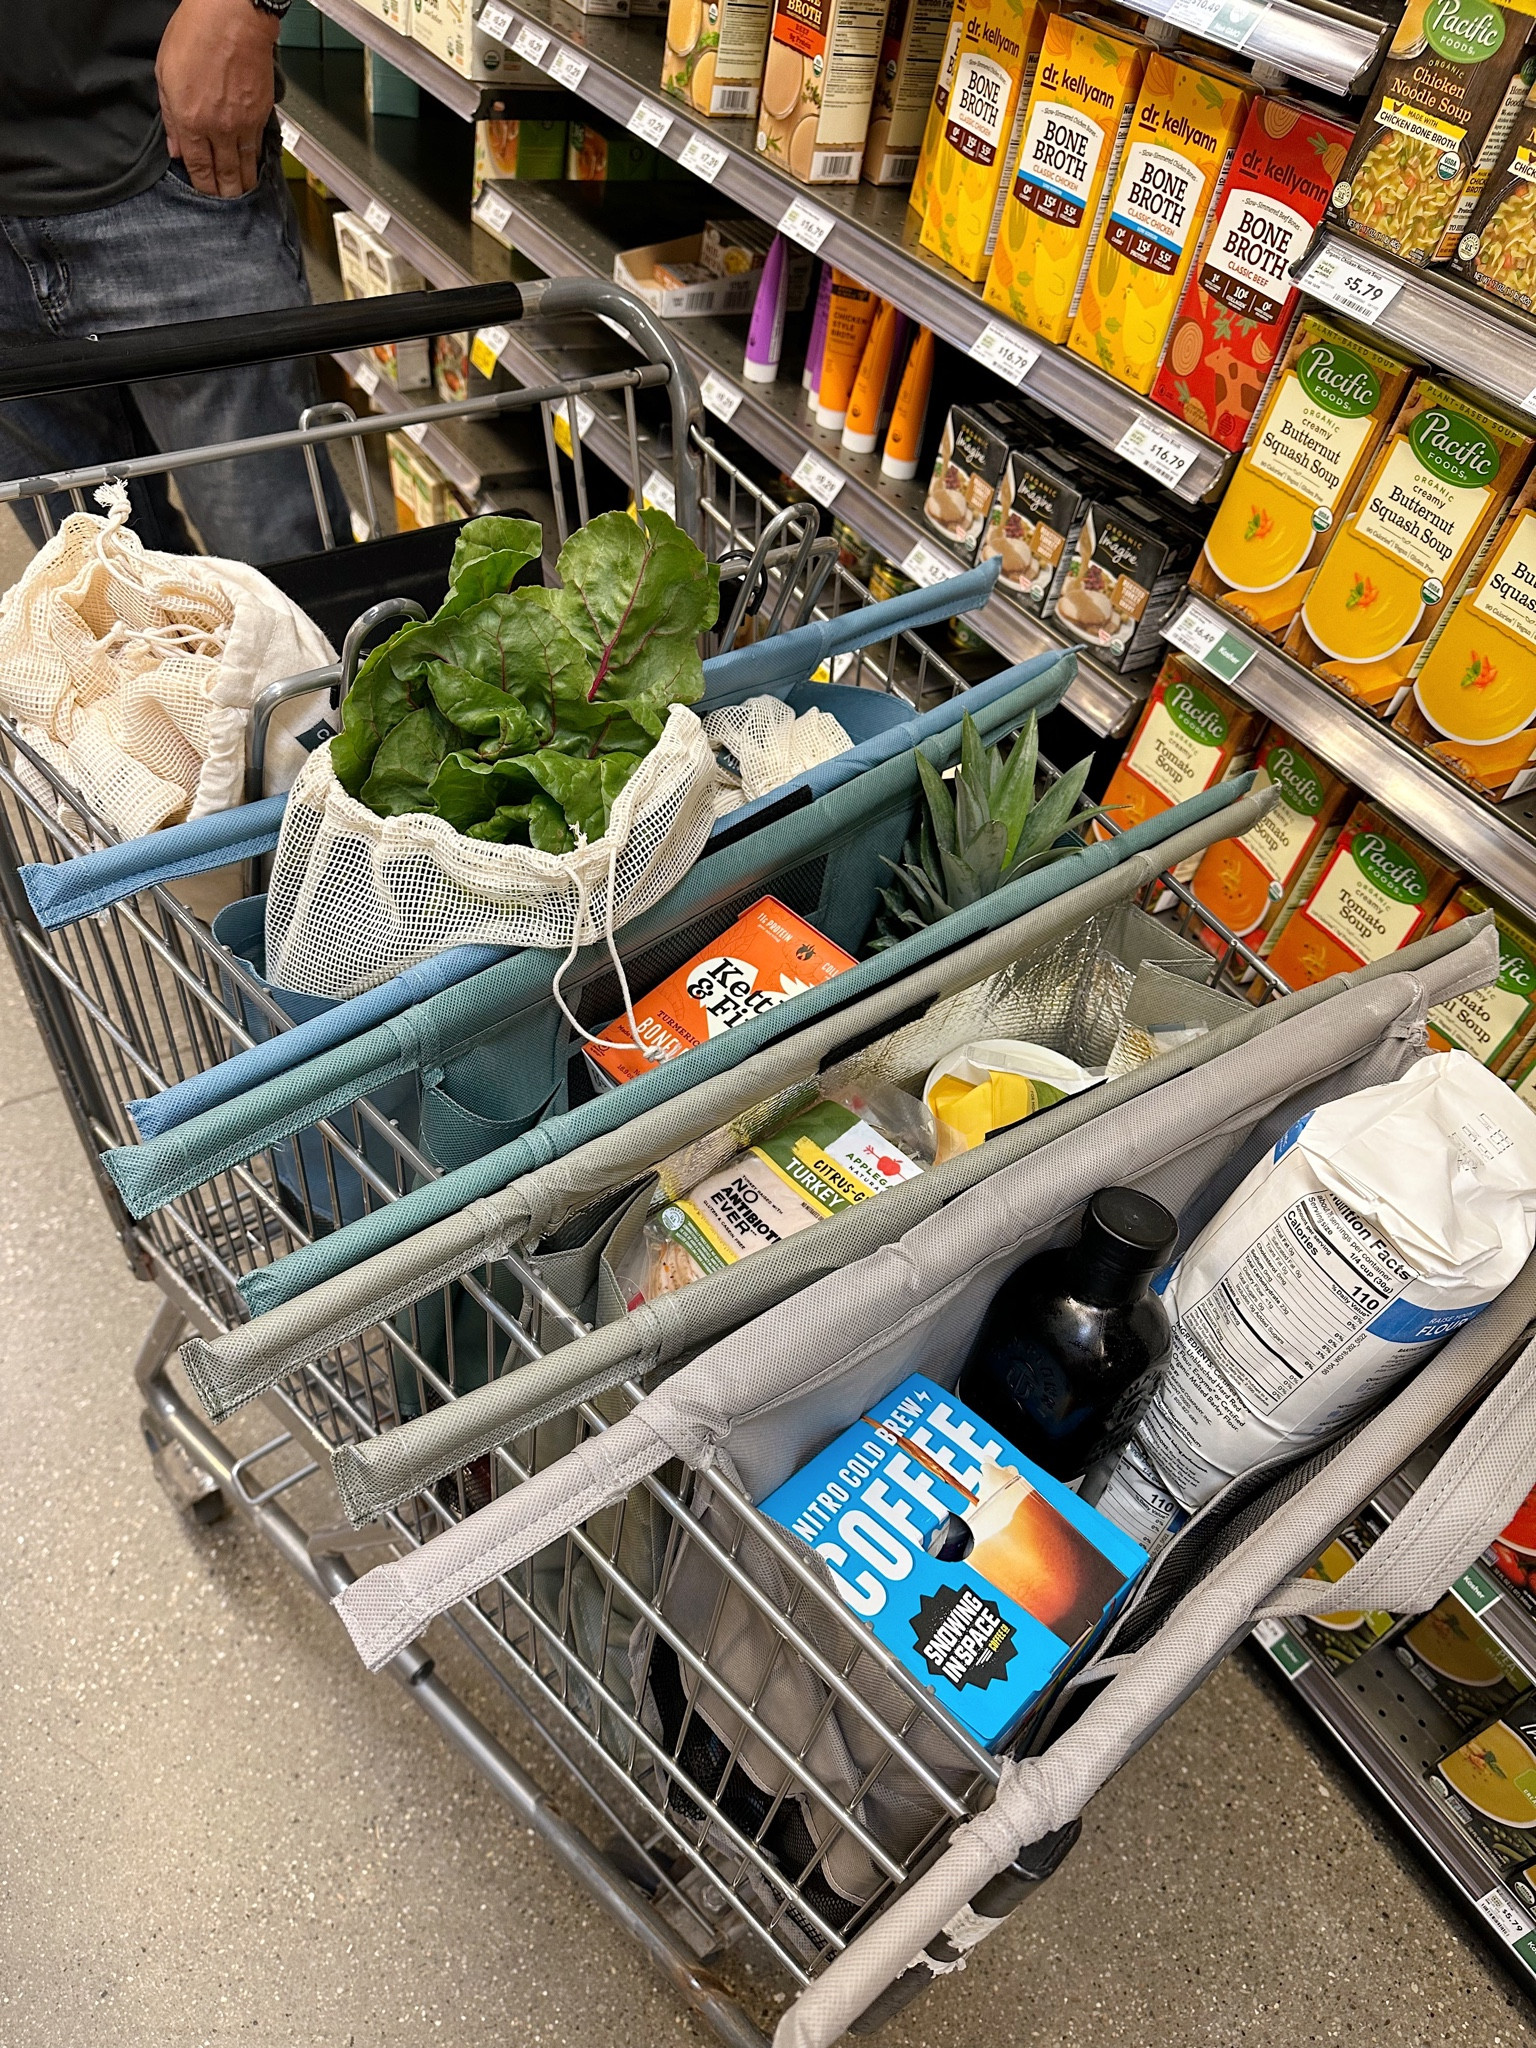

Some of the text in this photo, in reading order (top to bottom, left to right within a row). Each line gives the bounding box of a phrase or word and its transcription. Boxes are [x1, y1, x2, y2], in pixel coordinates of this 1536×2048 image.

[787, 2, 822, 25] BROTH
[1432, 0, 1499, 47] Pacific
[966, 17, 1020, 58] dr. kellyann
[969, 70, 1001, 102] BONE
[1042, 63, 1115, 110] dr. kellyann
[1413, 66, 1466, 100] Chicken
[1428, 60, 1465, 79] ORGANIC
[959, 89, 999, 128] BROTH
[1391, 78, 1472, 125] Noodle Soup
[1407, 110, 1438, 128] MADE WITH
[1043, 120, 1089, 158] BONE
[1141, 104, 1217, 154] dr. kellyann
[1380, 111, 1457, 150] CHICKEN BONE BROTH
[1032, 139, 1088, 182] BROTH
[1032, 164, 1055, 181] CLASSIC
[1054, 173, 1079, 191] CHICKEN
[1241, 151, 1262, 173] dr.
[1264, 158, 1329, 205] kellyann
[1140, 162, 1189, 202] BONE
[1127, 182, 1187, 227] BROTH
[1127, 207, 1175, 236] CLASSIC CHICKEN
[1238, 210, 1293, 253] BONE
[1223, 231, 1290, 281] BROTH
[1228, 261, 1269, 287] CLASSIC BEEF
[1344, 276, 1383, 300] $5.79
[999, 345, 1028, 369] $16.79
[1311, 323, 1395, 370] PLANT-BASED SOUP
[1307, 347, 1373, 406] Pacific
[1301, 418, 1333, 441] creamy
[1303, 408, 1340, 433] ORGANIC
[1427, 385, 1517, 440] PLANT-BASED SOUP
[1150, 443, 1185, 471] $16.79
[1263, 432, 1309, 471] Squash
[1310, 461, 1339, 490] Soup
[1280, 420, 1342, 465] Butternut
[1419, 412, 1492, 475] Pacific
[1017, 478, 1053, 514] Imagine
[1413, 485, 1447, 509] creamy
[1414, 474, 1454, 503] ORGANIC
[1369, 497, 1453, 561] Squash Soup
[1388, 485, 1455, 536] Butternut
[1098, 529, 1138, 565] Imagine
[1106, 523, 1143, 550] ORGANIC
[1194, 625, 1215, 644] $6.49
[1218, 646, 1241, 665] Kosher
[1171, 683, 1222, 739] Pacific
[1155, 738, 1195, 779] Tomato
[1155, 757, 1183, 785] Soup
[1273, 747, 1320, 808] Pacific
[1359, 833, 1420, 898] Pacific
[1338, 888, 1387, 937] Tomato
[1355, 888, 1385, 915] creamy
[1356, 881, 1392, 912] ORGANIC
[766, 919, 793, 942] PROTEIN
[1338, 907, 1373, 940] Soup
[687, 977, 713, 1000] &
[656, 1010, 701, 1047] TURMERIC
[1456, 1009, 1491, 1044] Soup
[731, 1177, 758, 1204] NO
[757, 1189, 773, 1206] RAISED
[785, 1156, 845, 1208] TURKEY
[813, 1159, 867, 1202] CITRUS-G
[849, 1165, 880, 1191] NATURA
[703, 1200, 735, 1239] GLUTEN CASEIN
[1274, 1224, 1284, 1238] Total
[1295, 1204, 1332, 1256] Amount per serving
[1250, 1248, 1264, 1270] Sodium
[1256, 1242, 1278, 1274] Cholesterol
[1287, 1210, 1380, 1311] Calories 110
[1308, 1196, 1394, 1294] Serving size 1/4 cup (30g)
[1331, 1215, 1393, 1282] servings per container
[1369, 1238, 1411, 1281] Facts
[1224, 1277, 1237, 1298] Protein
[1245, 1255, 1281, 1305] Total Carbohydrate
[1336, 1289, 1351, 1304] Daily
[1175, 1321, 1215, 1370] INGREDIENTS:
[1415, 1318, 1469, 1337] FLOUR
[1172, 1352, 1239, 1432] Organic Malted Barley Flour.
[1179, 1349, 1192, 1370] Flour,
[1220, 1399, 1246, 1427] Certified
[1186, 1348, 1242, 1413] Unbleached Hard Red
[791, 1396, 926, 1543] NITRO COLD BREW
[814, 1402, 1003, 1617] COFFEE
[1151, 1493, 1175, 1513] 110
[1463, 1575, 1485, 1599] Kosher
[923, 1590, 983, 1666] SNOWING
[1501, 1907, 1523, 1933] $5.79
